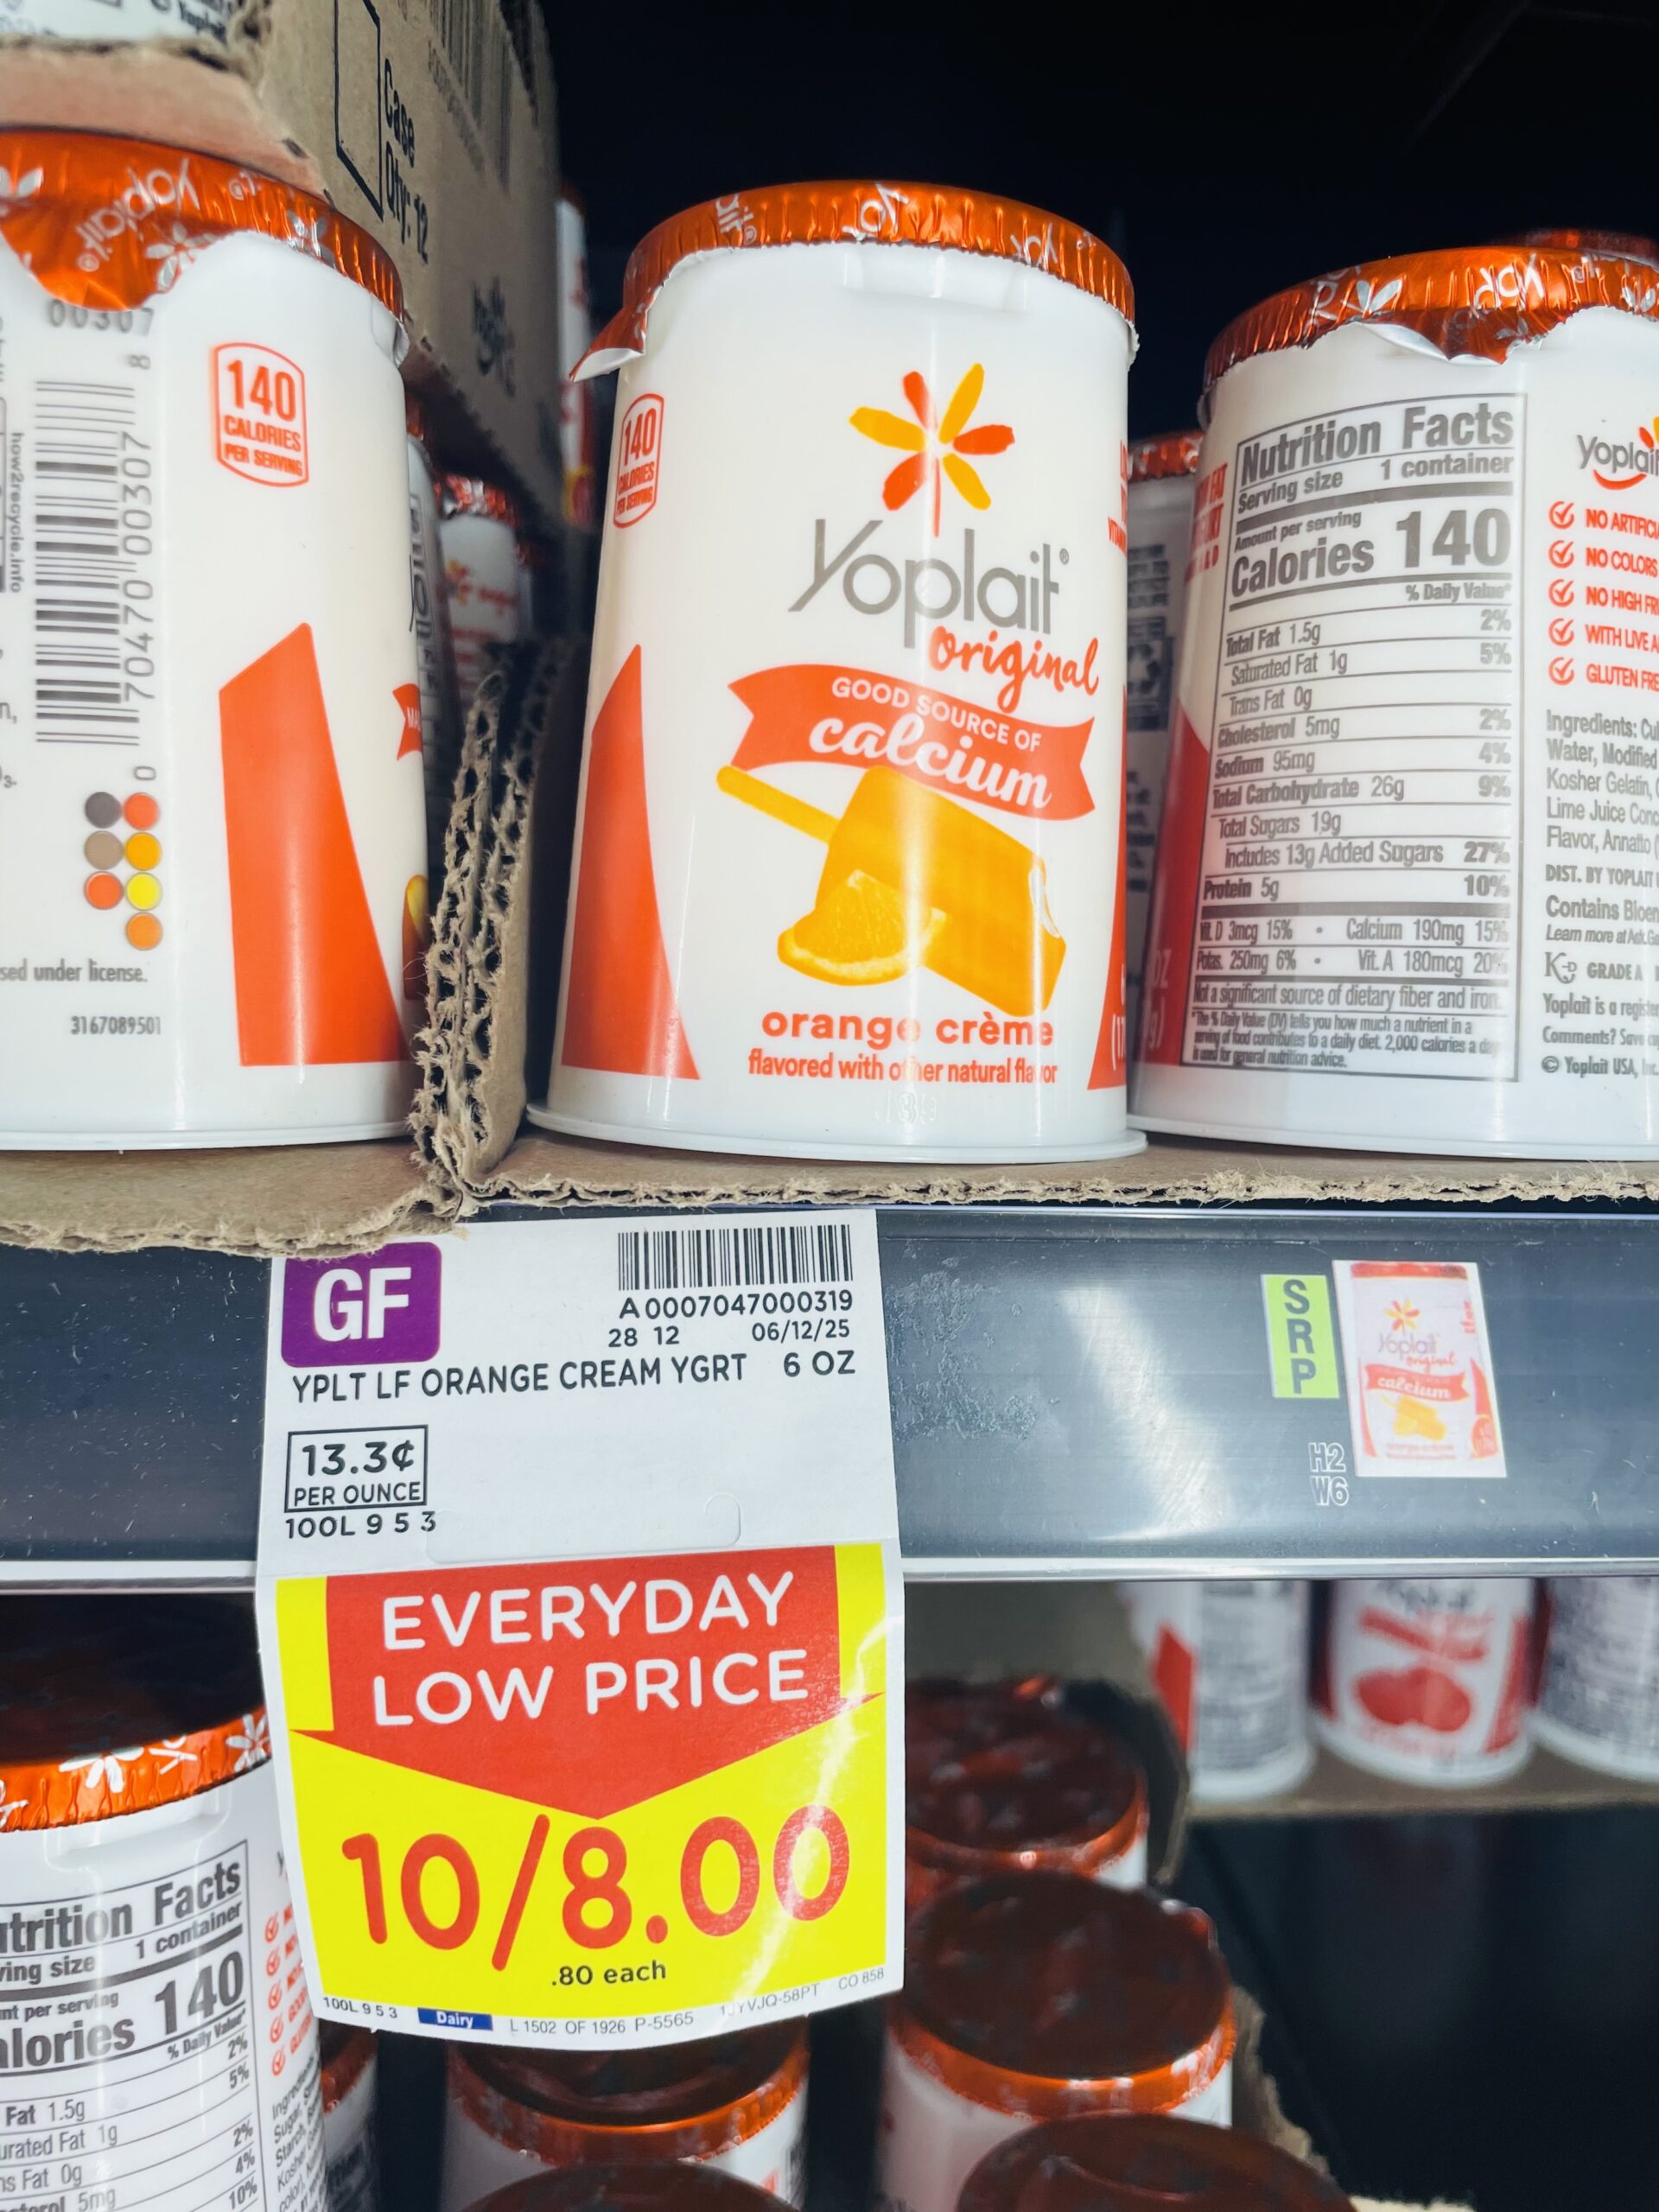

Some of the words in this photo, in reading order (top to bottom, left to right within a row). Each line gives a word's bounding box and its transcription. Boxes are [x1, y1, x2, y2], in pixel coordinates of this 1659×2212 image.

[385, 57, 415, 168] Case
[226, 359, 296, 422] 140
[224, 415, 302, 452] CALORIES
[624, 408, 657, 467] 140
[1241, 420, 1381, 486] Nutrition
[1402, 404, 1514, 450] Facts
[224, 442, 250, 464] PER
[253, 448, 302, 477] SERVING
[618, 461, 655, 496] CALORIES
[1238, 480, 1298, 514] Serving
[1304, 471, 1343, 494] size
[1402, 453, 1514, 479] container
[1234, 528, 1277, 553] Amount
[1280, 522, 1301, 543] per
[1306, 511, 1362, 534] serving
[1586, 508, 1608, 529] NO
[1231, 537, 1375, 598] Calories
[1395, 508, 1512, 569] 140
[1586, 547, 1608, 568] NO
[1611, 550, 1657, 578] COLORS
[1424, 583, 1460, 603] Daily
[1586, 585, 1608, 607] NO
[1611, 588, 1642, 613] HIGH
[1480, 608, 1512, 632] 2%
[1257, 626, 1281, 650] Fat
[1290, 622, 1321, 646] 1.5g
[1585, 624, 1622, 646] WITH
[1625, 629, 1649, 652] LIVE
[1479, 642, 1512, 665] 5%
[927, 626, 1100, 715] original
[1231, 656, 1291, 687] Saturated
[1295, 652, 1319, 675] Fat
[1329, 650, 1349, 675] 1g
[1586, 664, 1638, 688] GLUTEN
[831, 677, 911, 710] GOOD
[915, 694, 1009, 745] SOURCE
[1014, 728, 1042, 752] OF
[1229, 692, 1260, 717] Trans
[1263, 688, 1285, 711] Fat
[1294, 686, 1313, 710] 0g
[1217, 717, 1295, 749] Cholesterol
[1305, 715, 1341, 740] 5mg
[1479, 708, 1512, 731] 2%
[1547, 709, 1637, 738] Ingredients:
[809, 713, 1053, 810] calcium
[1273, 750, 1315, 773] 95mg
[1546, 738, 1598, 767] Water,
[1602, 742, 1657, 770] Modified
[1246, 777, 1360, 804] Carbohydrate
[1370, 776, 1404, 801] 26g
[1547, 767, 1601, 791] Kosher
[1606, 771, 1652, 800] Gelatin,
[1547, 796, 1585, 820] Lime
[1589, 799, 1625, 823] Juice
[1218, 817, 1246, 839] Total
[1249, 813, 1300, 840] Sugars
[1312, 810, 1342, 836] 19g
[1224, 845, 1281, 869] Includes
[1319, 841, 1374, 864] Added
[1379, 840, 1444, 868] Sugars
[1464, 841, 1510, 864] 27%
[1547, 825, 1599, 853] Flavor,
[1602, 830, 1651, 855] Annatto
[1204, 878, 1252, 901] Protein
[1261, 876, 1280, 901] 5g
[1464, 874, 1510, 898] 10%
[1545, 864, 1582, 883] DIST.
[1606, 868, 1653, 888] YOPLAIT
[1546, 894, 1619, 920] Contains
[1267, 918, 1293, 940] 15%
[1346, 918, 1403, 941] Calcium
[1413, 918, 1465, 946] 190mg
[34, 958, 83, 982] under
[89, 958, 148, 982] license.
[1229, 950, 1268, 975] 250mg
[1403, 950, 1464, 978] 180mcg
[1586, 962, 1632, 981] GRADE
[1280, 988, 1324, 1005] source
[1345, 984, 1395, 1012] dietary
[1399, 985, 1434, 1007] fiber
[1437, 987, 1465, 1009] and
[1542, 992, 1591, 1019] Yoplait
[761, 1012, 922, 1051] orange
[1404, 1017, 1449, 1034] nutrient
[1542, 1026, 1616, 1045] Comments?
[1384, 1033, 1418, 1053] 2,000
[1421, 1037, 1465, 1053] calories
[748, 1048, 835, 1079] flavored
[838, 1051, 884, 1082] with
[947, 1058, 1012, 1084] natural
[314, 1267, 412, 1343] GF
[608, 1328, 639, 1348] 28
[653, 1325, 680, 1345] 12
[752, 1319, 850, 1344] 06/12/25
[292, 1372, 367, 1403] YPLT
[377, 1370, 411, 1399] LF
[421, 1363, 549, 1396] ORANGE
[559, 1357, 661, 1389] CREAM
[671, 1353, 747, 1383] YGRT
[784, 1351, 801, 1377] 6
[811, 1350, 855, 1376] OZ
[1376, 1376, 1452, 1399] calcium
[302, 1440, 415, 1477] 13.3¢
[1308, 1442, 1346, 1472] H2
[294, 1486, 336, 1507] PER
[343, 1481, 422, 1504] OUNCE
[1309, 1475, 1350, 1506] W6
[285, 1515, 356, 1539] 100L
[366, 1513, 383, 1535] 9
[394, 1512, 410, 1534] 5
[420, 1510, 436, 1532] 3
[382, 1571, 794, 1650] EVERYDAY
[372, 1665, 555, 1728] LOW
[585, 1649, 810, 1715] PRICE
[340, 1803, 851, 1973] 10/8.00
[0, 1904, 132, 1953] trition
[154, 1860, 241, 1927] Facts
[50, 1955, 96, 1978] size
[156, 1902, 242, 1953] container
[551, 1964, 594, 1986] .80
[603, 1959, 667, 1985] each
[838, 1976, 859, 1992] CO
[861, 1967, 885, 1985] 858
[0, 2017, 135, 2070] lories
[156, 1950, 244, 2035] 140
[24, 2004, 52, 2023] per
[57, 1992, 119, 2017] serving
[323, 1996, 359, 2013] 100L
[362, 2002, 372, 2015] 9
[376, 2005, 385, 2017] 5
[389, 2006, 398, 2019] 3
[435, 2010, 474, 2030] Dairy
[510, 2018, 518, 2033] L
[524, 2020, 557, 2034] 1502
[565, 2021, 586, 2035] OF
[593, 2021, 626, 2035] 1926
[635, 2012, 695, 2032] P-5565
[227, 2032, 248, 2060] 2%
[5, 2105, 36, 2127] Fat
[48, 2099, 86, 2122] 1.5g
[22, 2168, 48, 2191] Fat
[61, 2163, 83, 2188] 0g
[232, 2121, 254, 2149] 2%
[60, 2130, 86, 2153] Fat
